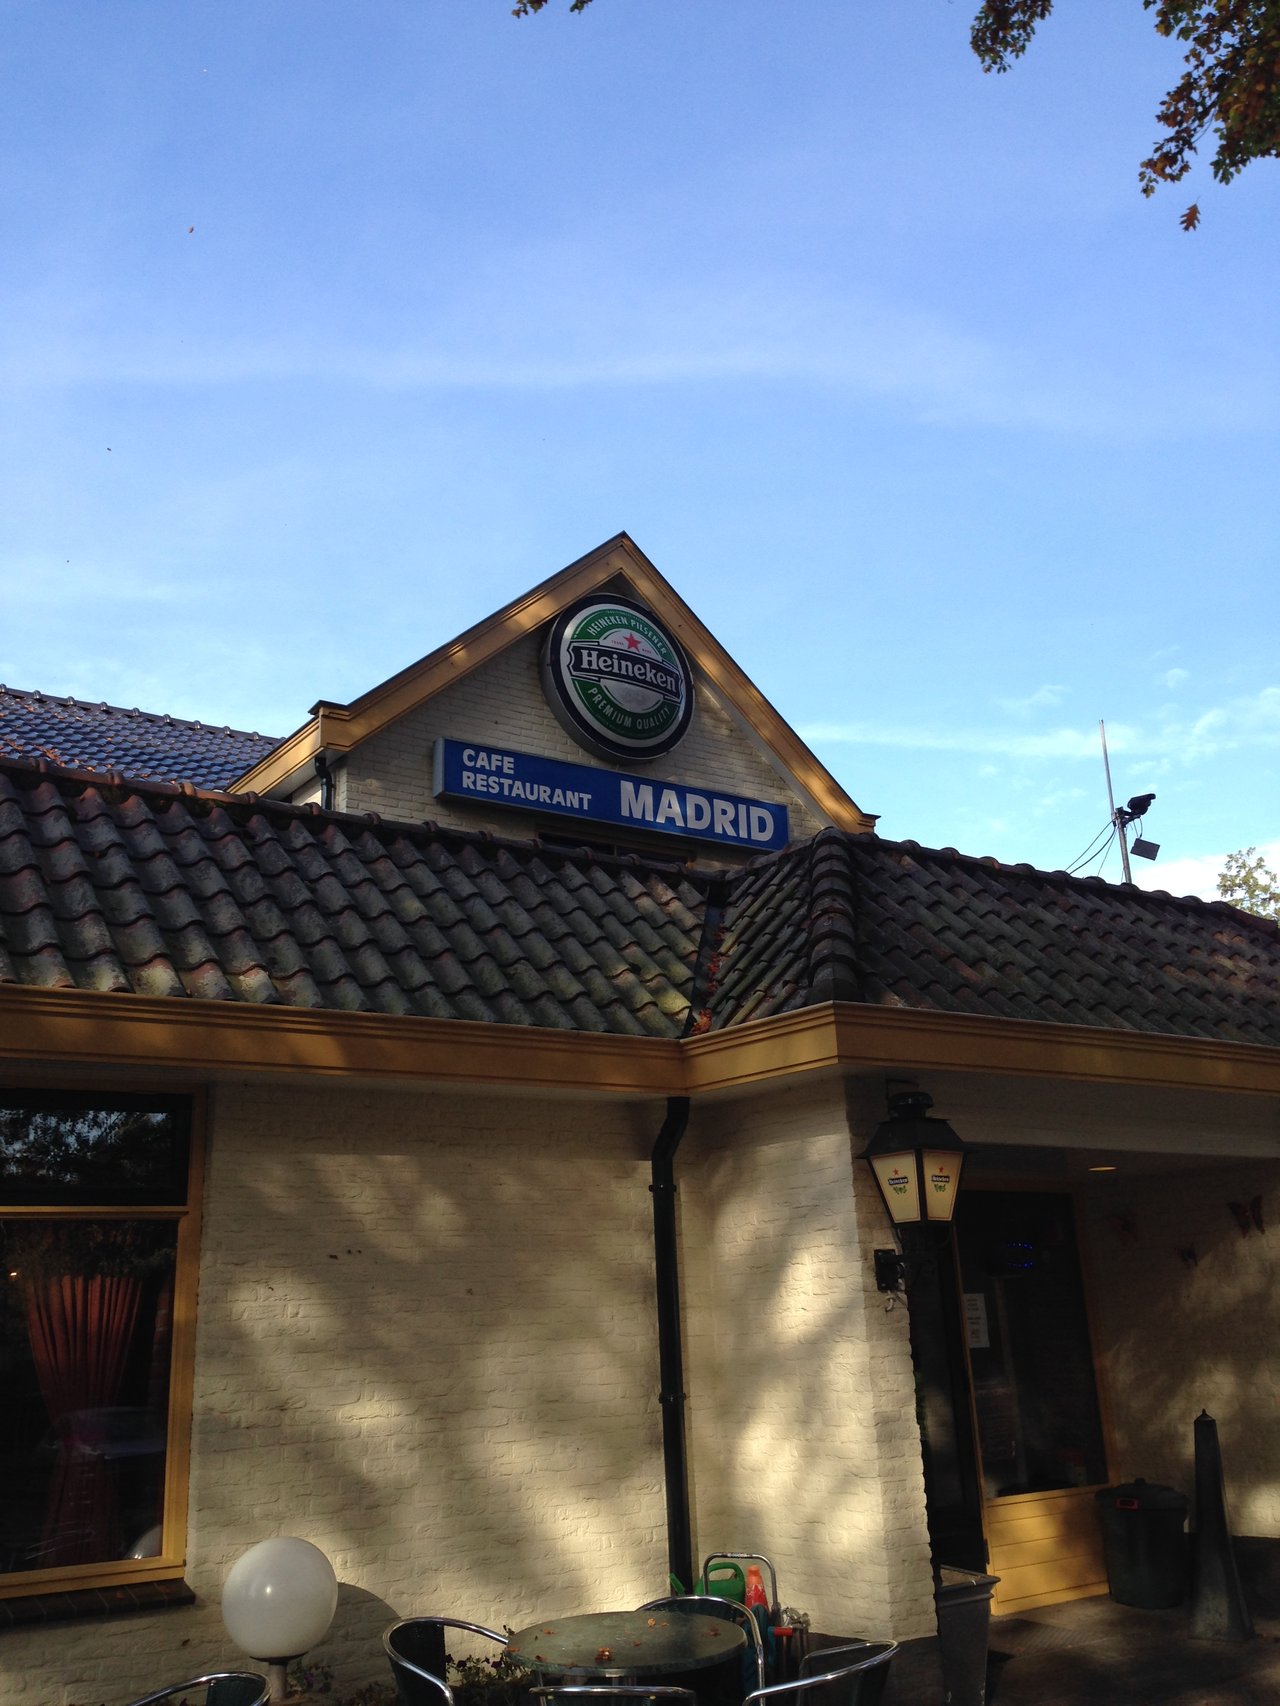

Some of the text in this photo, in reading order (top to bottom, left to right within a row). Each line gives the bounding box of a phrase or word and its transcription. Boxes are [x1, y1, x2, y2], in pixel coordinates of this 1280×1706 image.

[587, 615, 667, 655] HEINEKEN PILSENER
[580, 649, 677, 693] Heineken
[587, 687, 632, 728] PREMIUM
[636, 707, 670, 730] QUALITY
[462, 748, 515, 775] CAFE
[462, 770, 592, 811] RESTAURANT
[619, 780, 775, 842] MADRID
